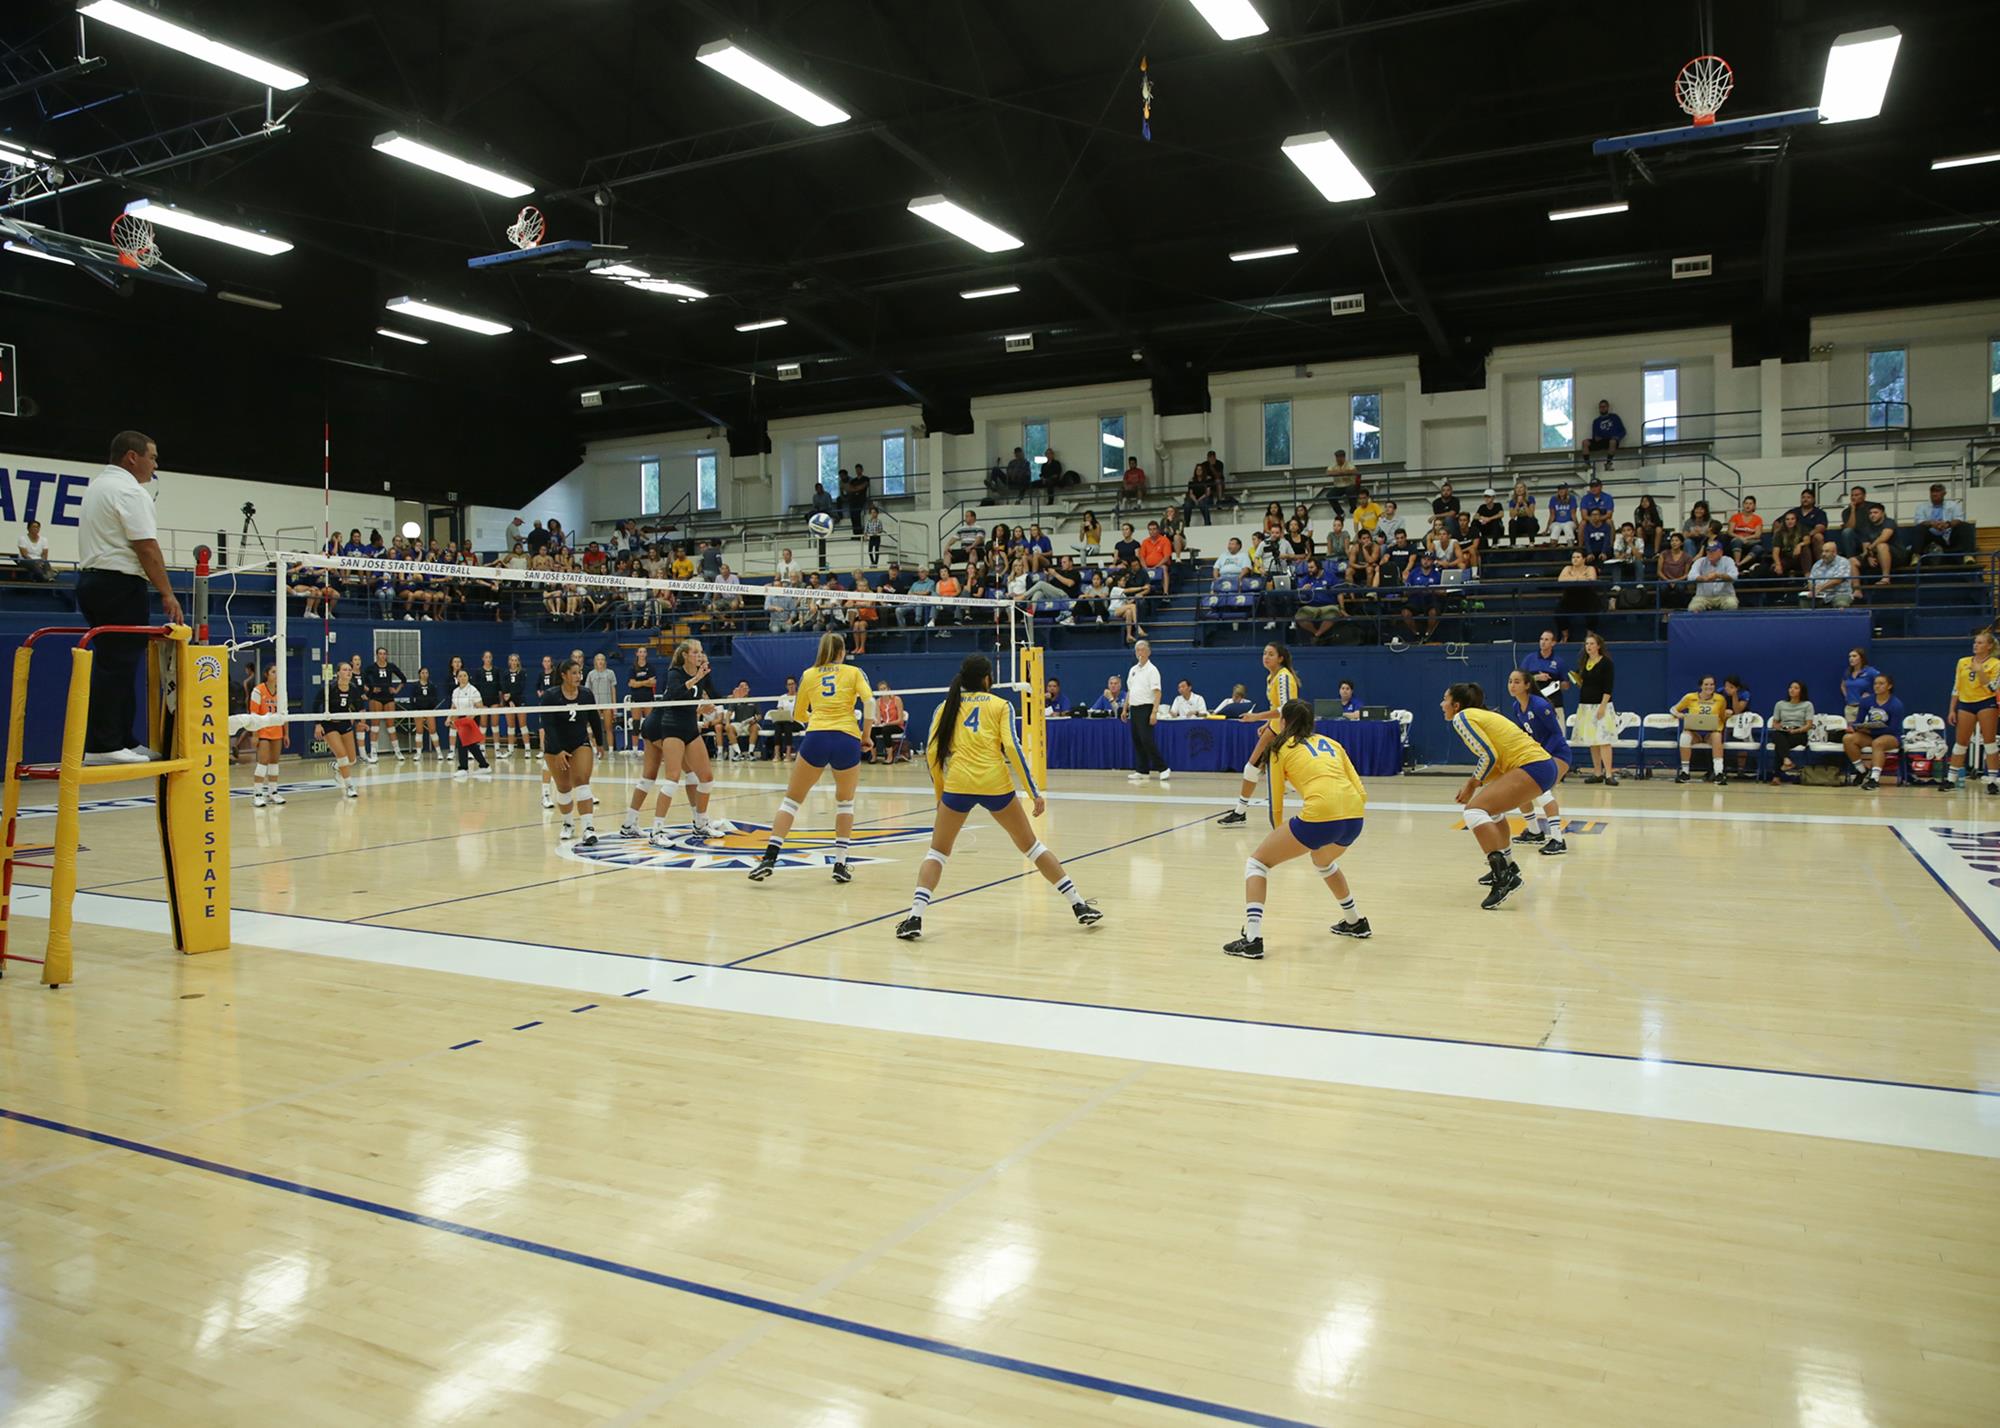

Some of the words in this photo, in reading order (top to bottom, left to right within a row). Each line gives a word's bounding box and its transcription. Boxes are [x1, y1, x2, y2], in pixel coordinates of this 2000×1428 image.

[340, 558, 360, 568] SAN
[362, 559, 385, 570] JOSE
[388, 562, 415, 572] STATE
[418, 563, 472, 575] VOLLEYBALL
[541, 572, 560, 581] JOSE
[562, 574, 582, 582] STATE
[584, 576, 626, 586] VOLLEYBALL
[715, 584, 749, 592] VOLLEYBALL
[252, 624, 265, 635] EXIT
[1968, 672, 1976, 681] 9
[822, 676, 836, 696] 5
[340, 698, 346, 706] 5
[568, 710, 576, 722] 2
[1700, 706, 1712, 714] 32
[202, 695, 214, 744] SAN
[964, 706, 980, 732] 4
[314, 742, 328, 752] EXIT
[1304, 737, 1336, 758] 14
[202, 754, 216, 822] JOSÉ
[204, 831, 216, 918] STATE
